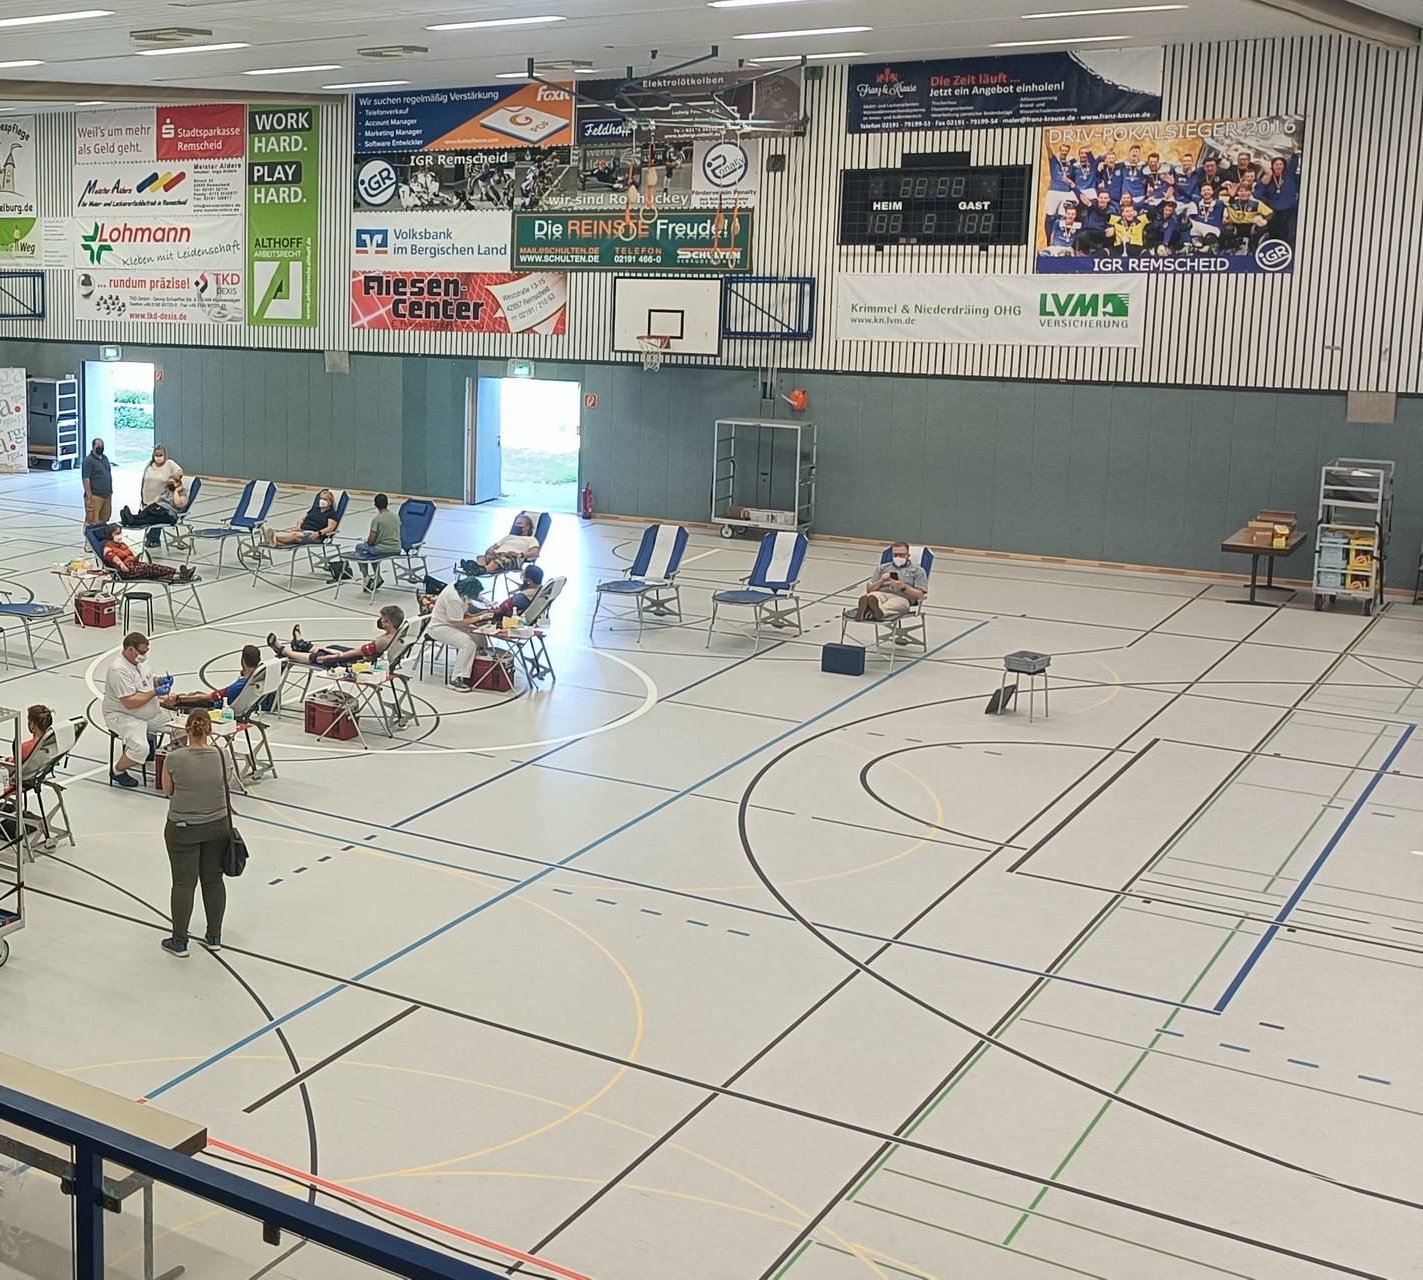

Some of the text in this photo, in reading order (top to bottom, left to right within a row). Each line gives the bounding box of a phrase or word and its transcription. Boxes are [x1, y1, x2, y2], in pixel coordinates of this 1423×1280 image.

[642, 76, 724, 88] Elektrolötkolben
[931, 76, 950, 87] Die
[953, 74, 977, 86] Zeit
[978, 72, 1007, 84] läuft
[881, 84, 889, 95] &
[929, 81, 1065, 97] Jetzt ein Angebot einholen!
[359, 90, 499, 106] Wir suchen regelmäßig Verstärkung
[365, 107, 409, 116] Telefonverkauf
[255, 111, 310, 131] WORK
[364, 118, 418, 127] Account Manager
[77, 124, 152, 138] Weil's um mehr
[177, 126, 241, 140] Stadtsparkasse
[364, 128, 423, 138] Marketing Manager
[1048, 118, 1297, 145] DRIV-POKALSIEGER 2016
[78, 142, 143, 156] als Geld geht.
[177, 141, 223, 151] Remscheid
[254, 135, 308, 153] HARD.
[364, 138, 423, 147] Software Entwickler
[409, 151, 508, 167] IGR Remscheid
[253, 164, 297, 182] PLAY
[359, 167, 396, 198] iGR
[253, 186, 307, 204] HARD.
[548, 192, 690, 209] wir sind Rohockey
[872, 201, 903, 211] HEIM
[958, 201, 991, 211] GAST
[97, 222, 192, 243] Lohmann
[393, 228, 453, 240] Volksbank
[534, 219, 563, 236] Die
[567, 219, 650, 237] REINSTE
[19, 242, 36, 254] Weg
[254, 237, 303, 249] ALTHOFF
[122, 239, 241, 267] Kleben mit Leidenschaft
[253, 250, 302, 258] ARBEITSRECHT
[393, 244, 507, 259] im Bergischen Land
[615, 247, 663, 255] TELEFON
[1258, 245, 1291, 265] iGR
[519, 254, 600, 263] WWW.SCHULTEN.DE
[614, 255, 662, 264] 02191 466-0
[1092, 257, 1230, 272] IGR REMSCHEID
[109, 277, 147, 289] rundum
[149, 277, 190, 291] präzise!
[213, 273, 241, 286] TKD
[363, 274, 468, 298] Fliesen-
[216, 287, 237, 295] DEXIS
[391, 297, 485, 321] Center
[850, 303, 1022, 319] Krimmel & Niederdräing OHG
[1039, 293, 1099, 317] LVM
[129, 311, 187, 321] www.tkd-dexis.de
[850, 316, 917, 325] www.kn.lvm.de
[1039, 319, 1129, 329] VERSICHERUNG
